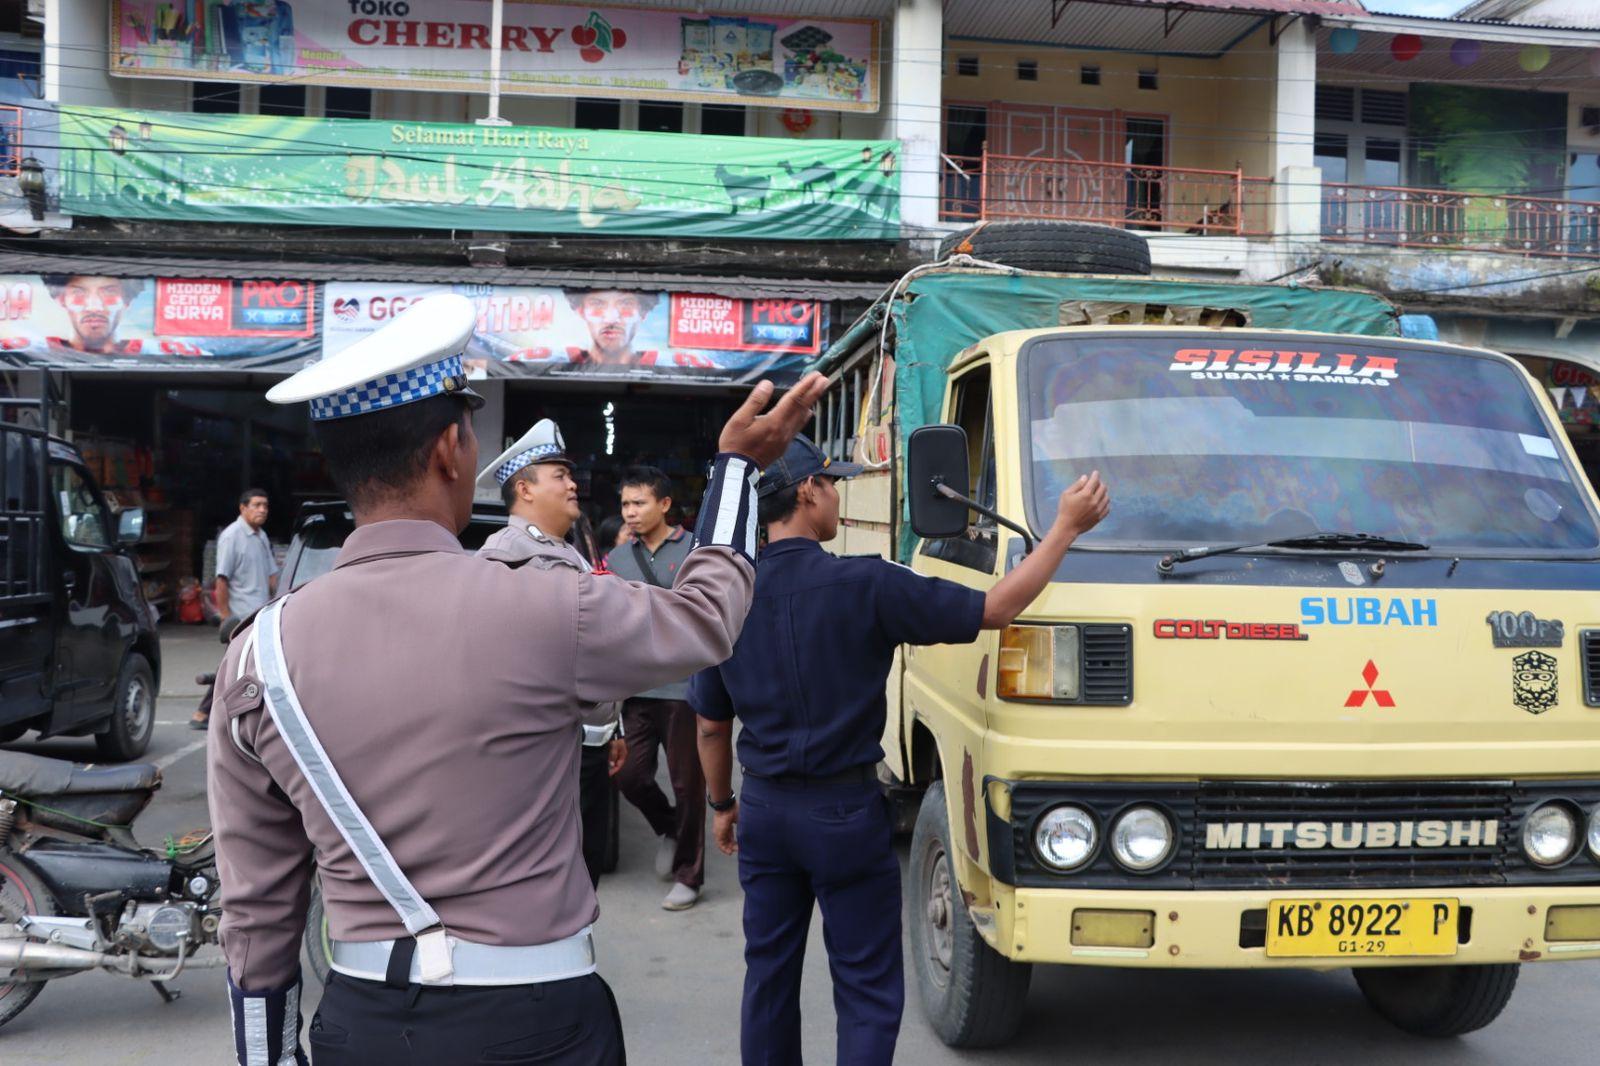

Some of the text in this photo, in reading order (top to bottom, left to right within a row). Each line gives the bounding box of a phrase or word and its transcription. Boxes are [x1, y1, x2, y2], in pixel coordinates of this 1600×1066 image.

[350, 0, 410, 17] TOKO
[348, 19, 565, 53] CHERRY
[391, 125, 589, 155] Selamat Hari Raya
[344, 152, 641, 228] Idul Adha
[166, 283, 222, 295] HIDDEN
[169, 294, 219, 306] GEM OF
[242, 281, 304, 308] PRO
[163, 305, 224, 321] SURYA
[680, 297, 733, 311] HIDDEN
[682, 308, 730, 320] GEM OF
[752, 300, 812, 324] PRO
[677, 319, 735, 335] SURYA
[1169, 348, 1399, 379] SISILIA
[1190, 371, 1391, 387] SUBAH SAMBAS
[1300, 597, 1437, 627] SUBAH
[1205, 819, 1499, 849] MITSUBISHI
[1277, 904, 1449, 936] KB 8922 P
